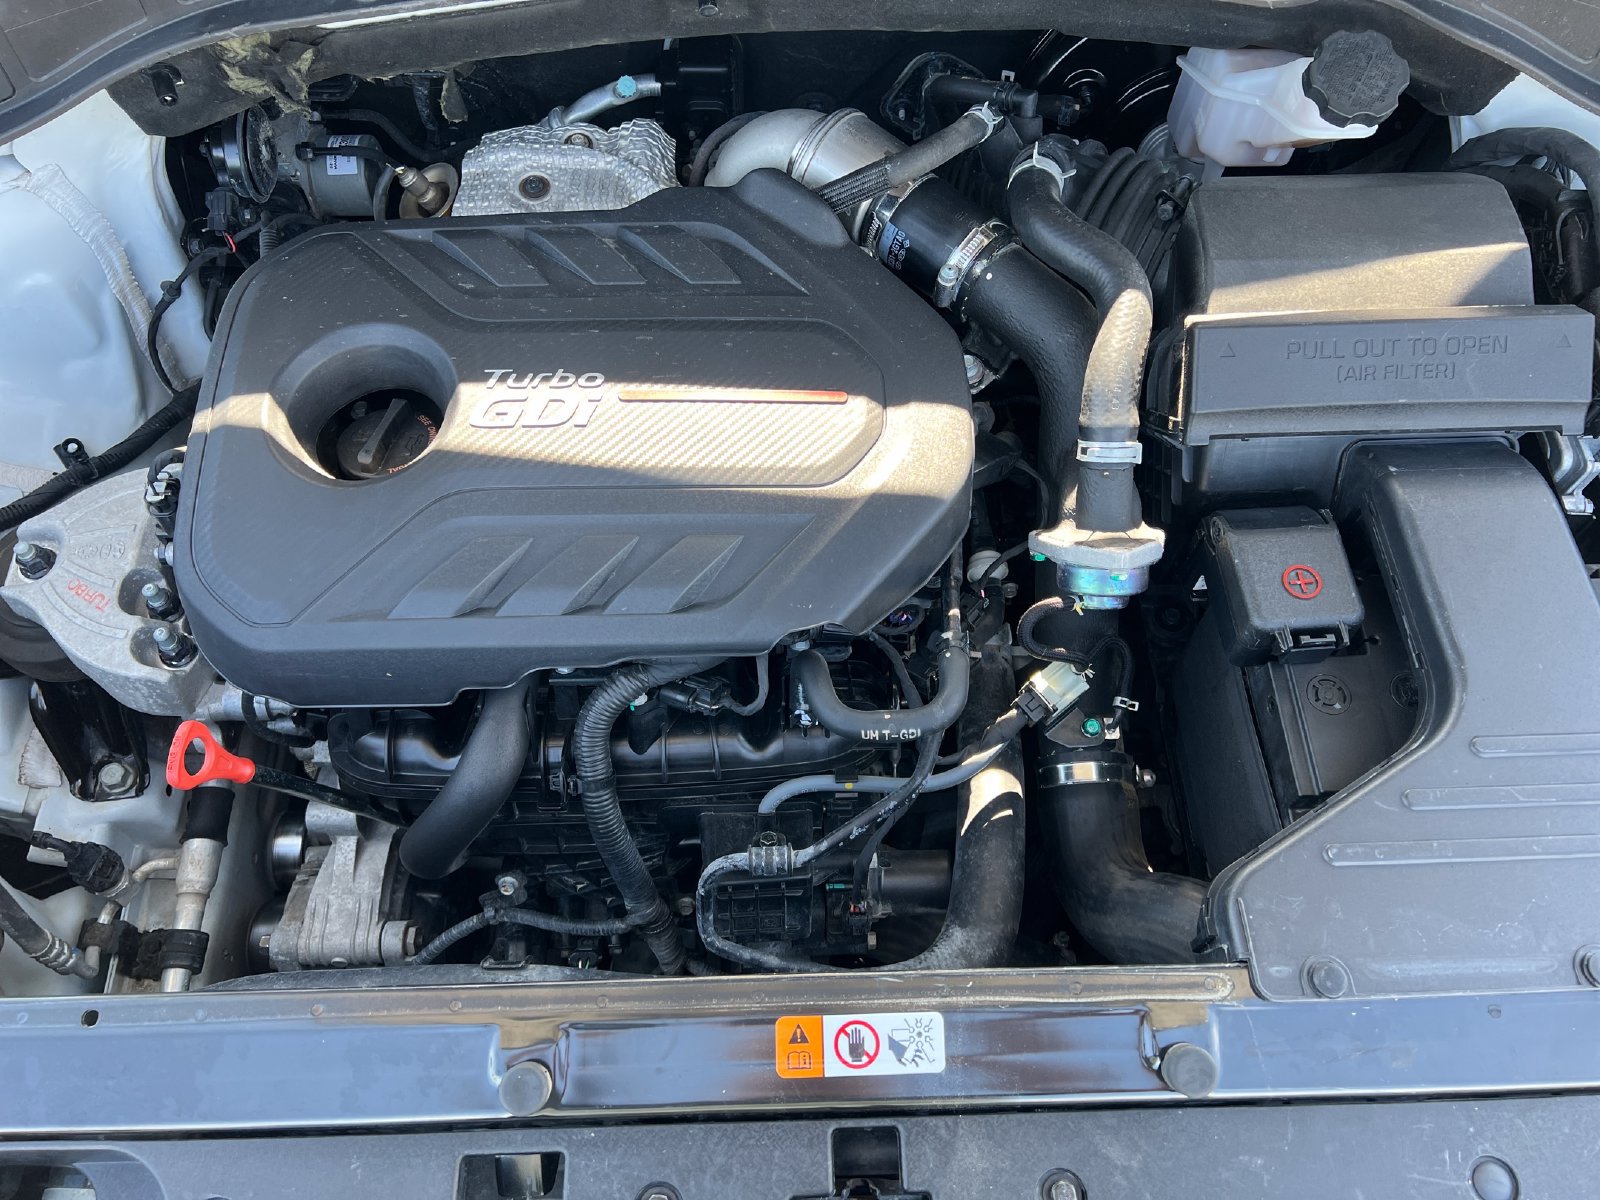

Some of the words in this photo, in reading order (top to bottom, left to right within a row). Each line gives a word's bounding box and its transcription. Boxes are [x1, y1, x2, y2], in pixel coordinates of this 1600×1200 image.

[1286, 338, 1345, 359] PULL
[1353, 338, 1401, 358] OUT
[1408, 337, 1437, 357] TO
[1445, 335, 1509, 356] OPEN
[484, 368, 605, 389] Turbo
[1336, 364, 1377, 383] (AIR
[1383, 362, 1456, 381] FILTER)
[861, 729, 879, 741] UM
